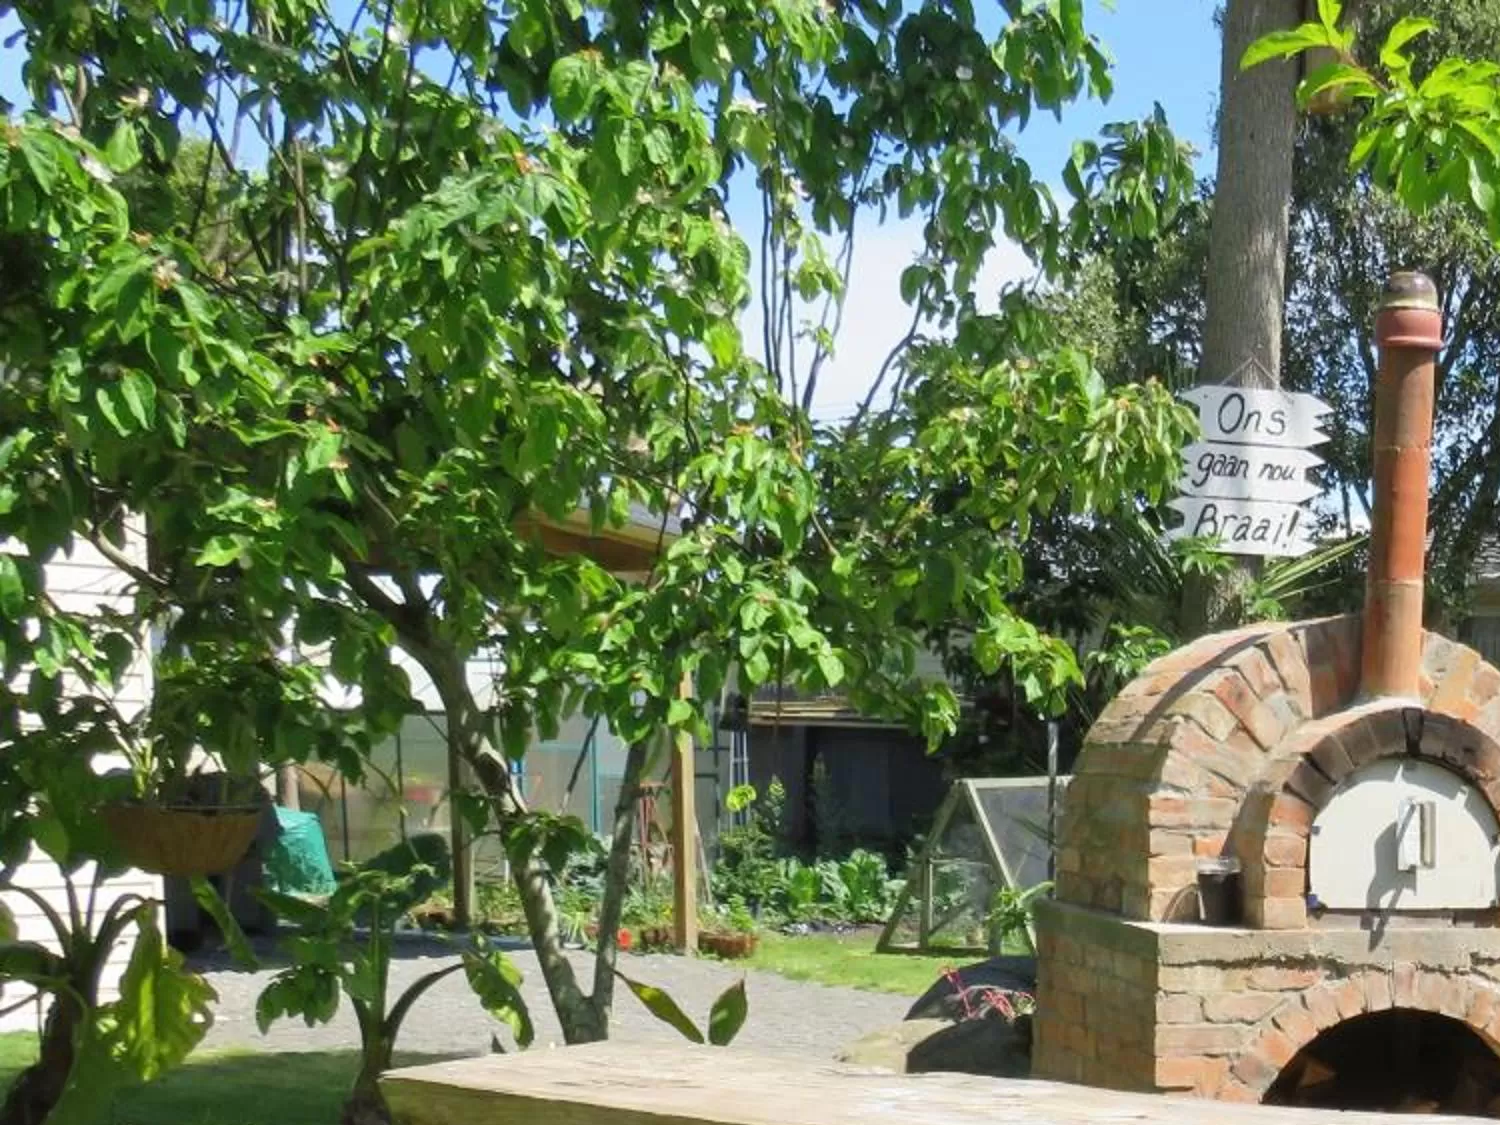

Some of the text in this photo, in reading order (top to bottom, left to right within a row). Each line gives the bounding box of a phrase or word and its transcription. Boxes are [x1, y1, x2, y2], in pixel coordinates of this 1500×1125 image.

[1217, 392, 1286, 436] Ons
[1191, 452, 1297, 488] gaan nou
[1193, 503, 1300, 549] Braai!
